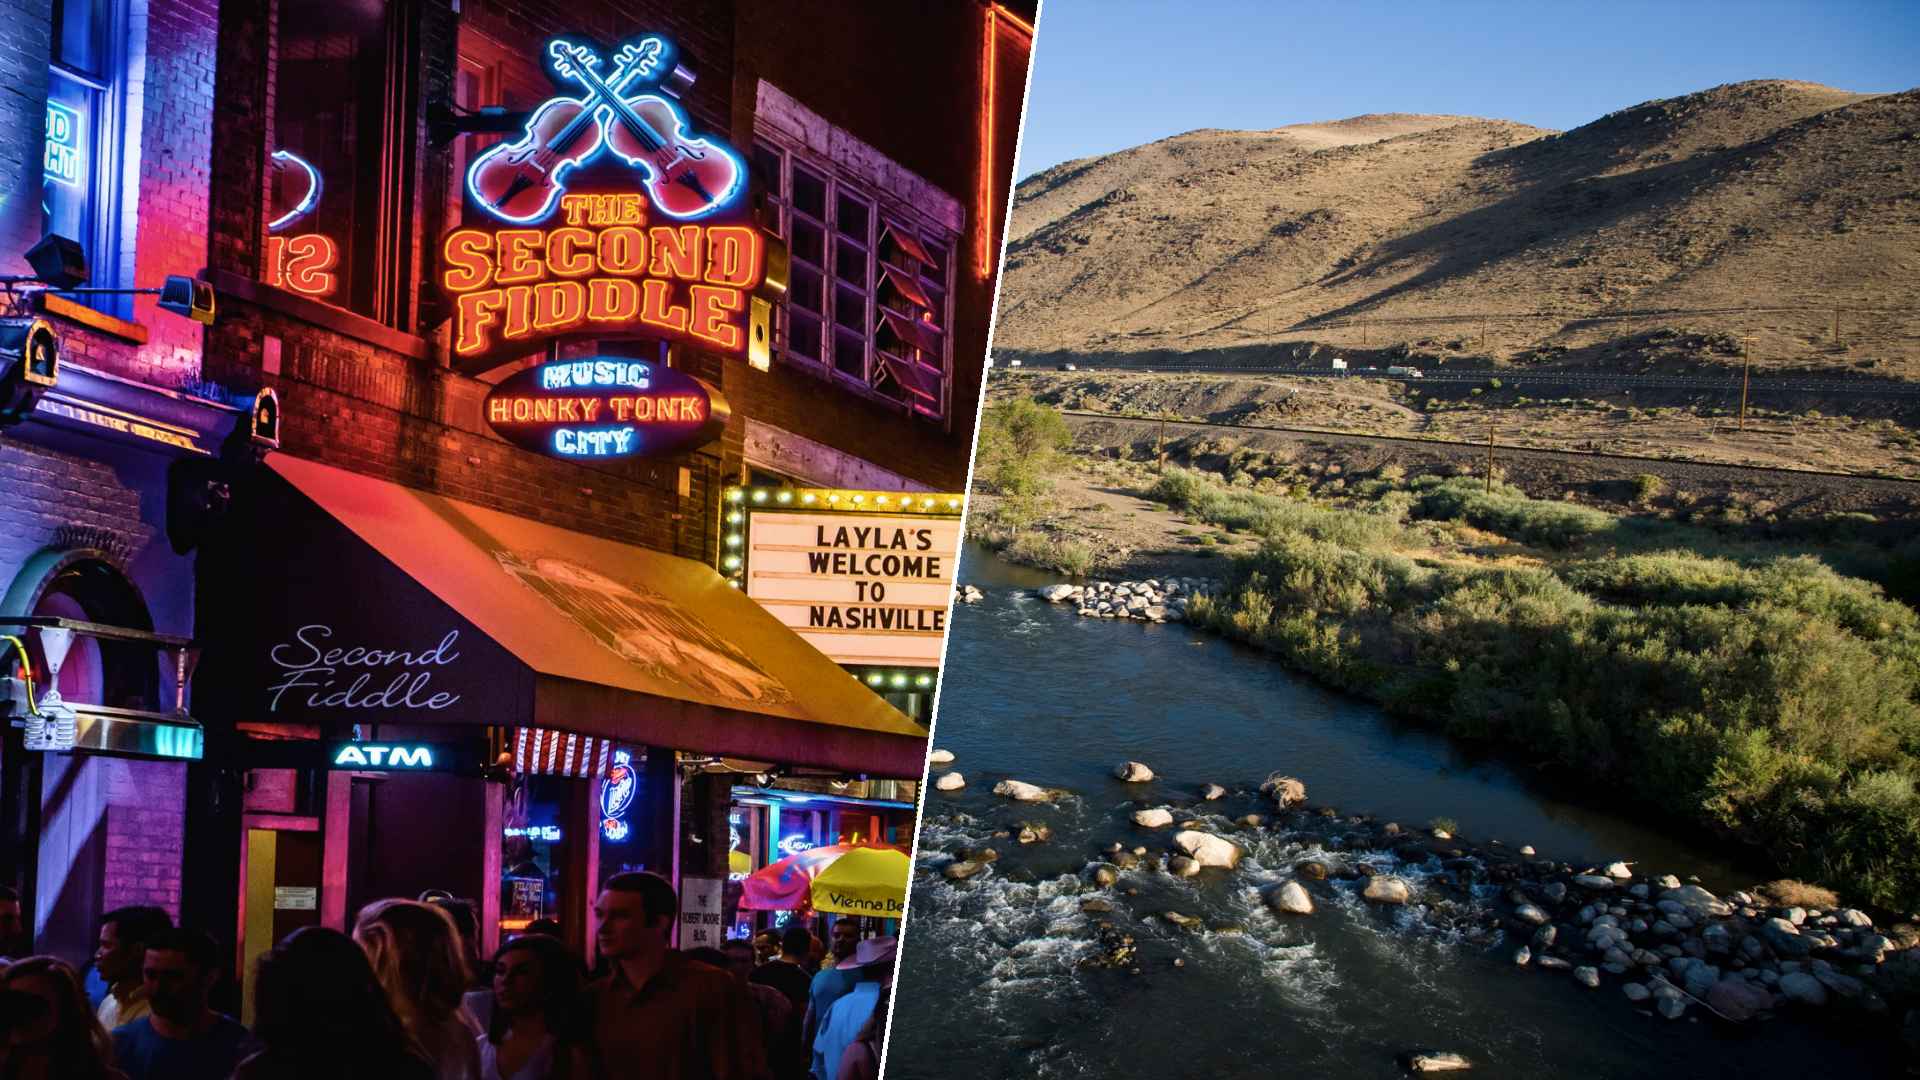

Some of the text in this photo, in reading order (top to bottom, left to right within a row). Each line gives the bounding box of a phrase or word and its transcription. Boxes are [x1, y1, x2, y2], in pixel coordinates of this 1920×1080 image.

[562, 194, 644, 225] THE
[445, 225, 758, 291] SECOND
[456, 279, 741, 352] FIDDLE
[543, 362, 650, 389] MUSIC
[490, 397, 703, 422] HONKY TONK
[555, 428, 635, 454] CITY
[816, 525, 933, 550] LAYLA'S
[808, 552, 941, 578] WELCOME
[855, 581, 885, 602] TO
[809, 606, 945, 631] NASHVILLE
[271, 624, 460, 669] Second
[267, 668, 461, 712] Fiddle
[335, 746, 433, 767] ATM
[830, 893, 882, 911] Vienna
